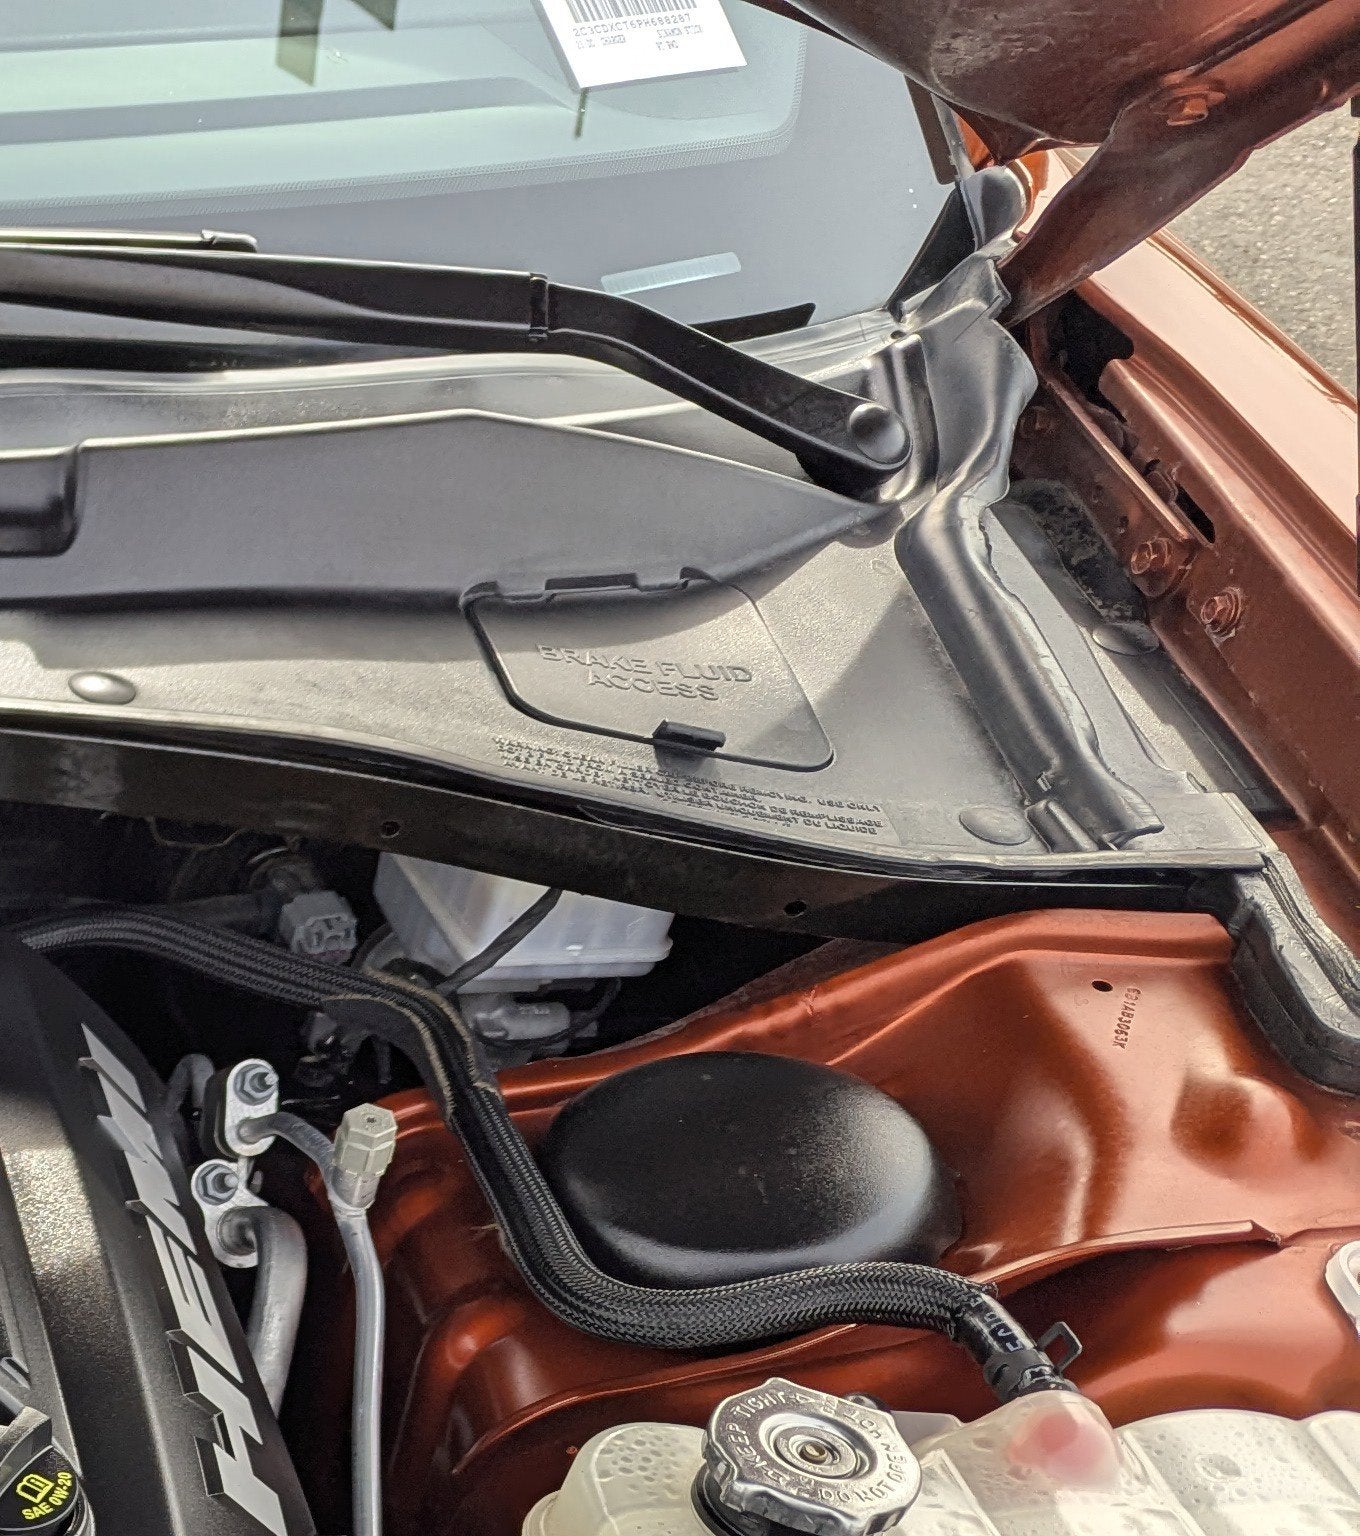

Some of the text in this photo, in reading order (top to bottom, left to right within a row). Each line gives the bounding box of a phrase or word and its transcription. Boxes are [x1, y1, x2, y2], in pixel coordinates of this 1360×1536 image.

[536, 644, 752, 683] BRAKE FLUID
[588, 671, 720, 701] ACCESS
[726, 1391, 786, 1469] KEEP TIGHT
[21, 1471, 73, 1521] SAE 0W-20
[818, 1487, 851, 1502] DO
[854, 1479, 896, 1503] NOT
